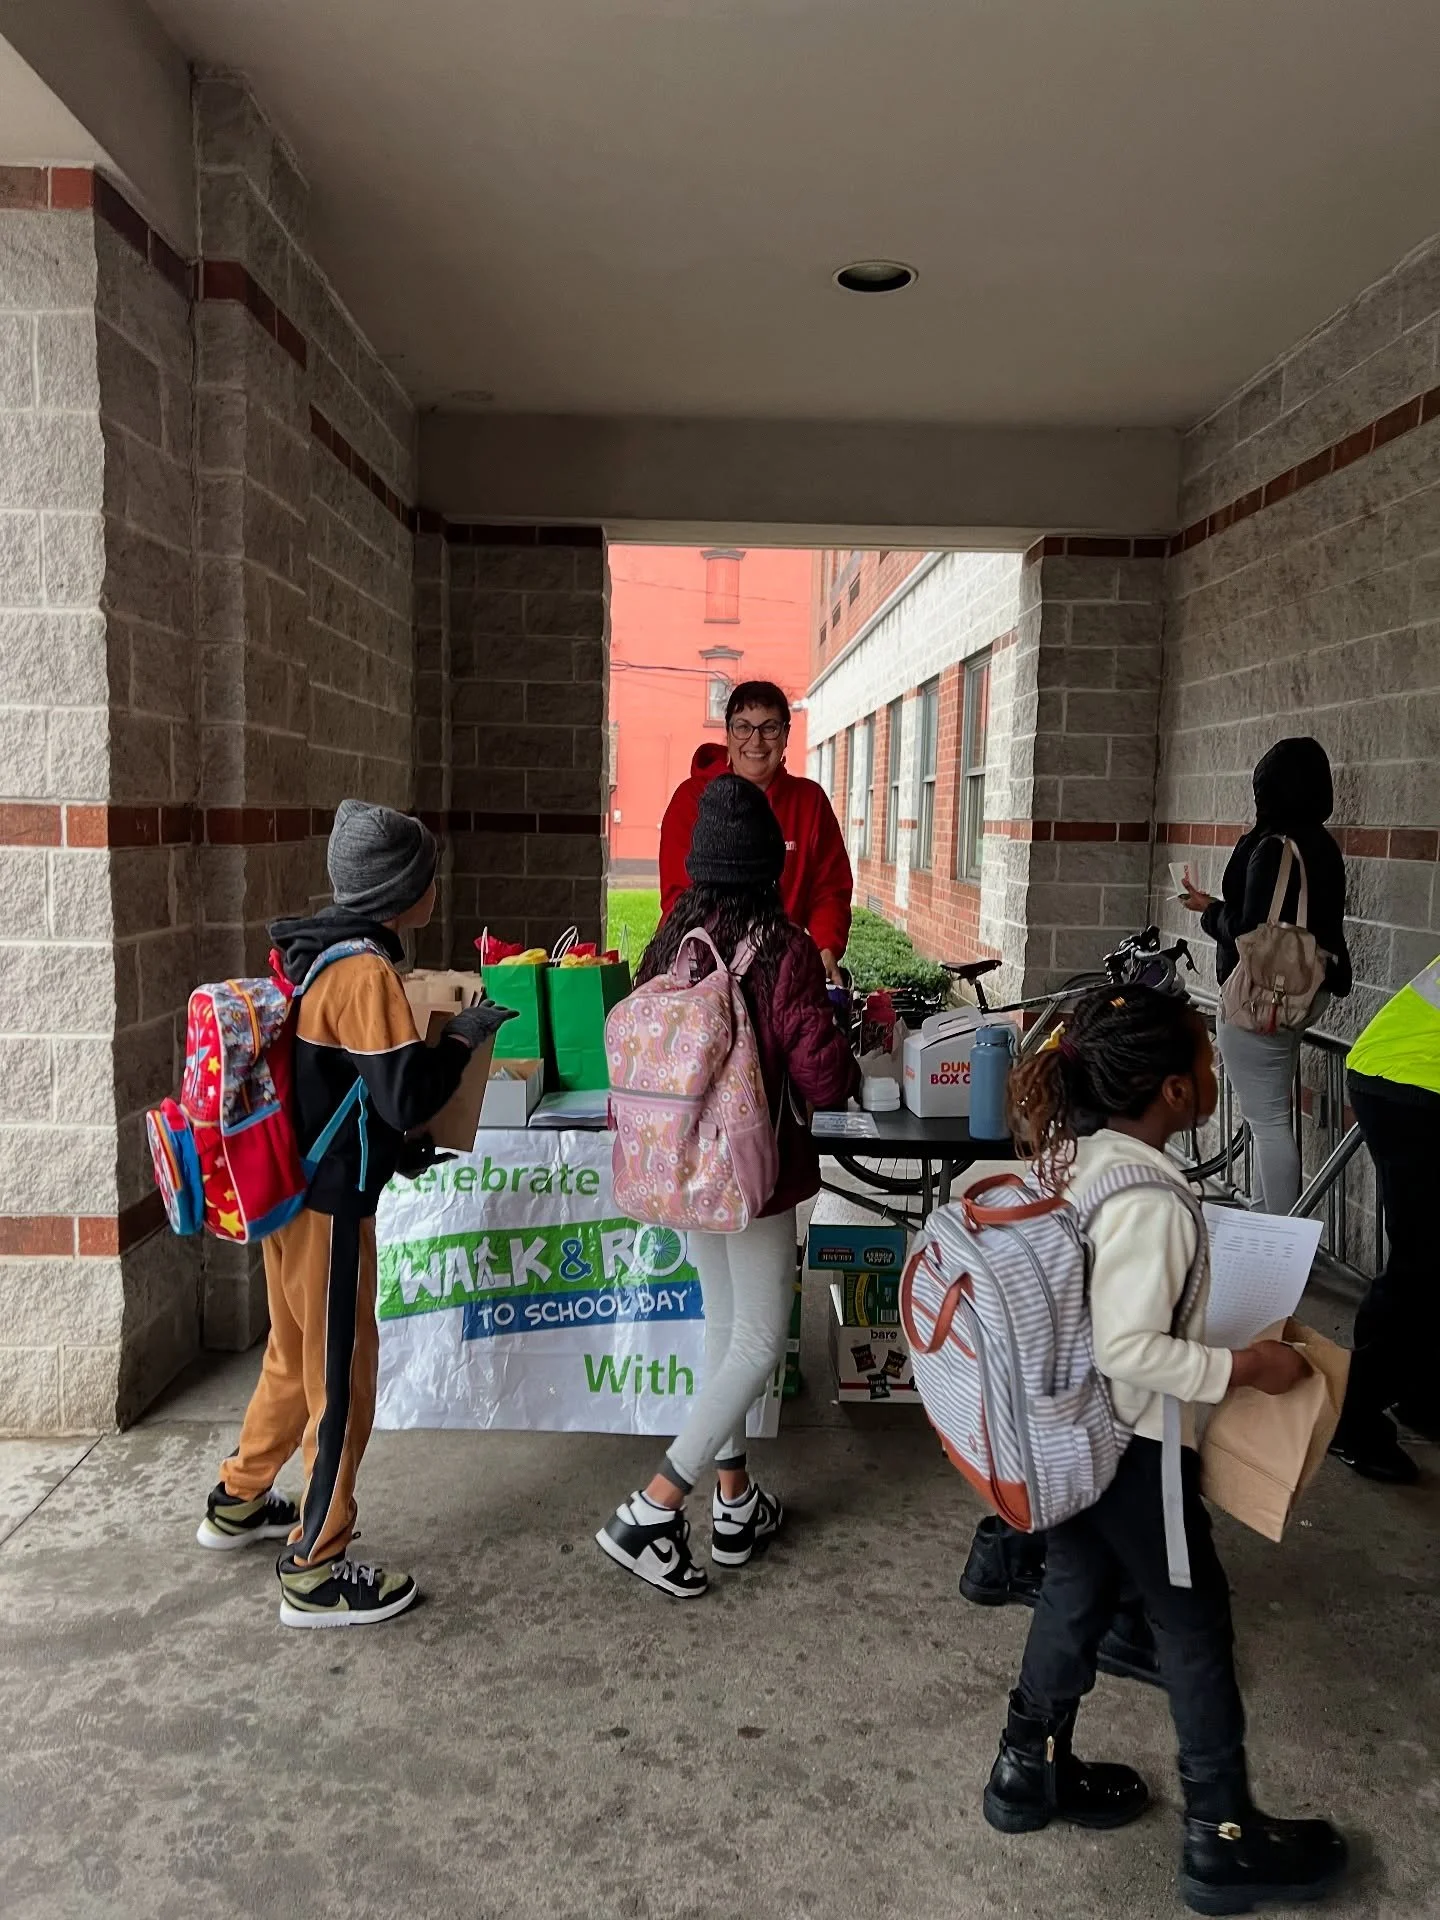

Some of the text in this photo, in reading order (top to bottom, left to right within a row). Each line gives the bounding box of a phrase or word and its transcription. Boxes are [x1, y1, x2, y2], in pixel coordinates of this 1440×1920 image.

[931, 1073, 959, 1084] BOX
[941, 1062, 970, 1072] DUN
[401, 1224, 688, 1305] WALK & RO
[478, 1288, 688, 1330] TO SCHOOL DAY
[871, 1329, 897, 1340] bare
[584, 1353, 694, 1396] With
